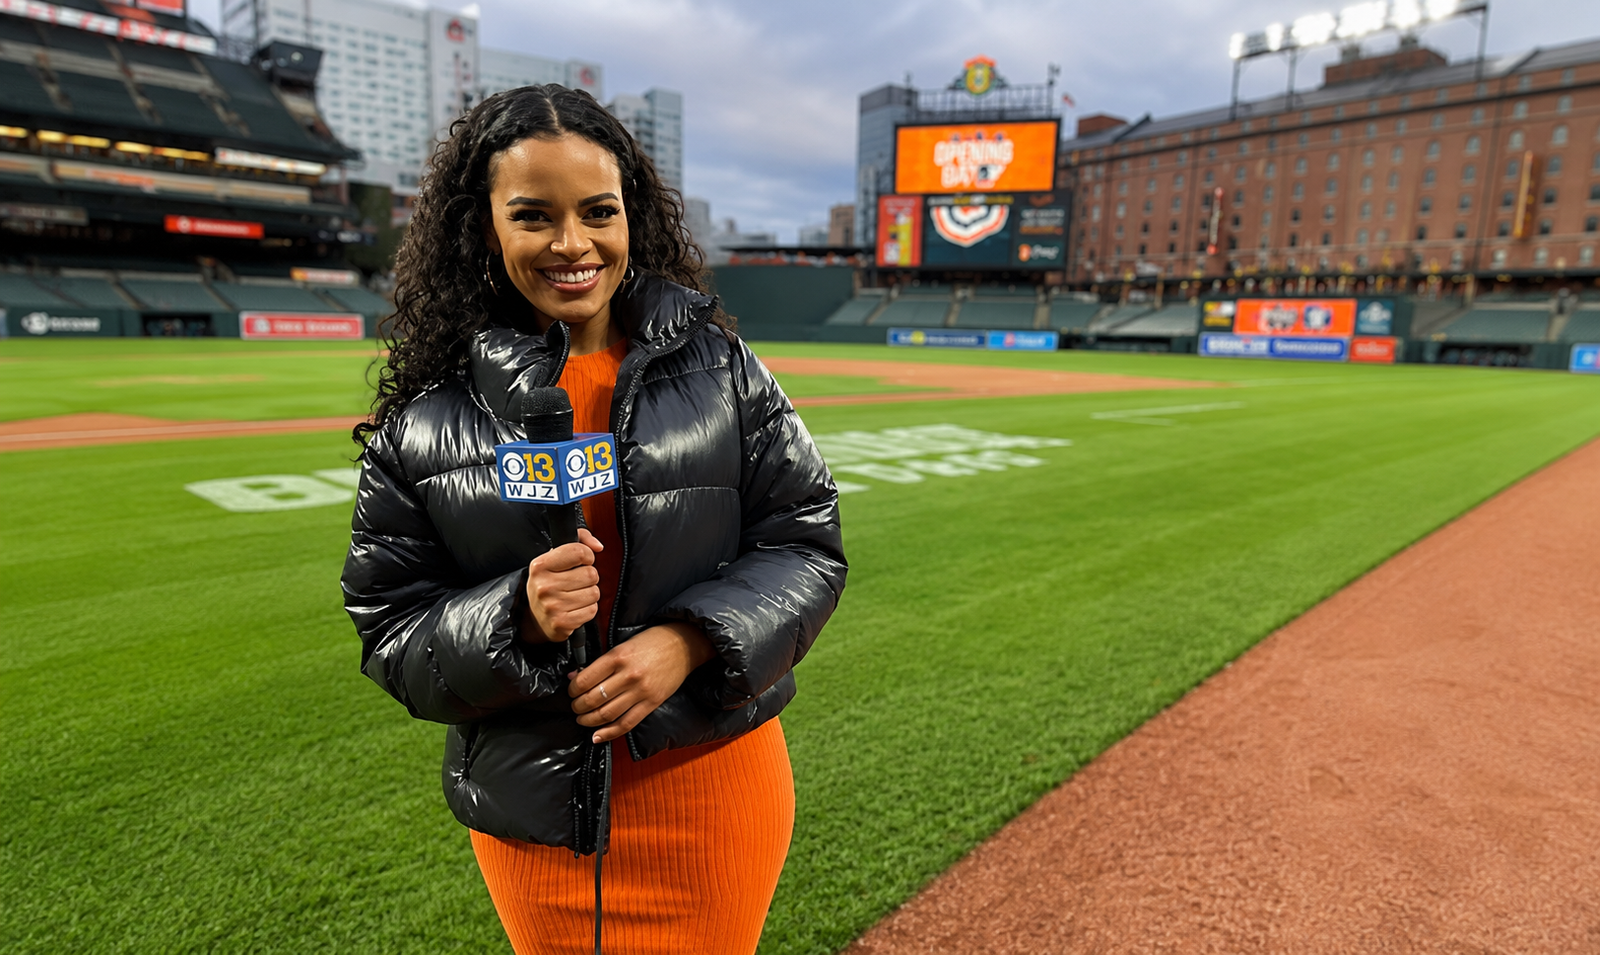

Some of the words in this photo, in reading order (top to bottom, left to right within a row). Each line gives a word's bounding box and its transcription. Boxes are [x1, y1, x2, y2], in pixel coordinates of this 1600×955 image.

[934, 139, 1014, 166] OPENING
[523, 453, 556, 482] 13
[584, 441, 613, 474] 13
[507, 484, 555, 499] WJZ
[570, 473, 610, 494] WJZ
